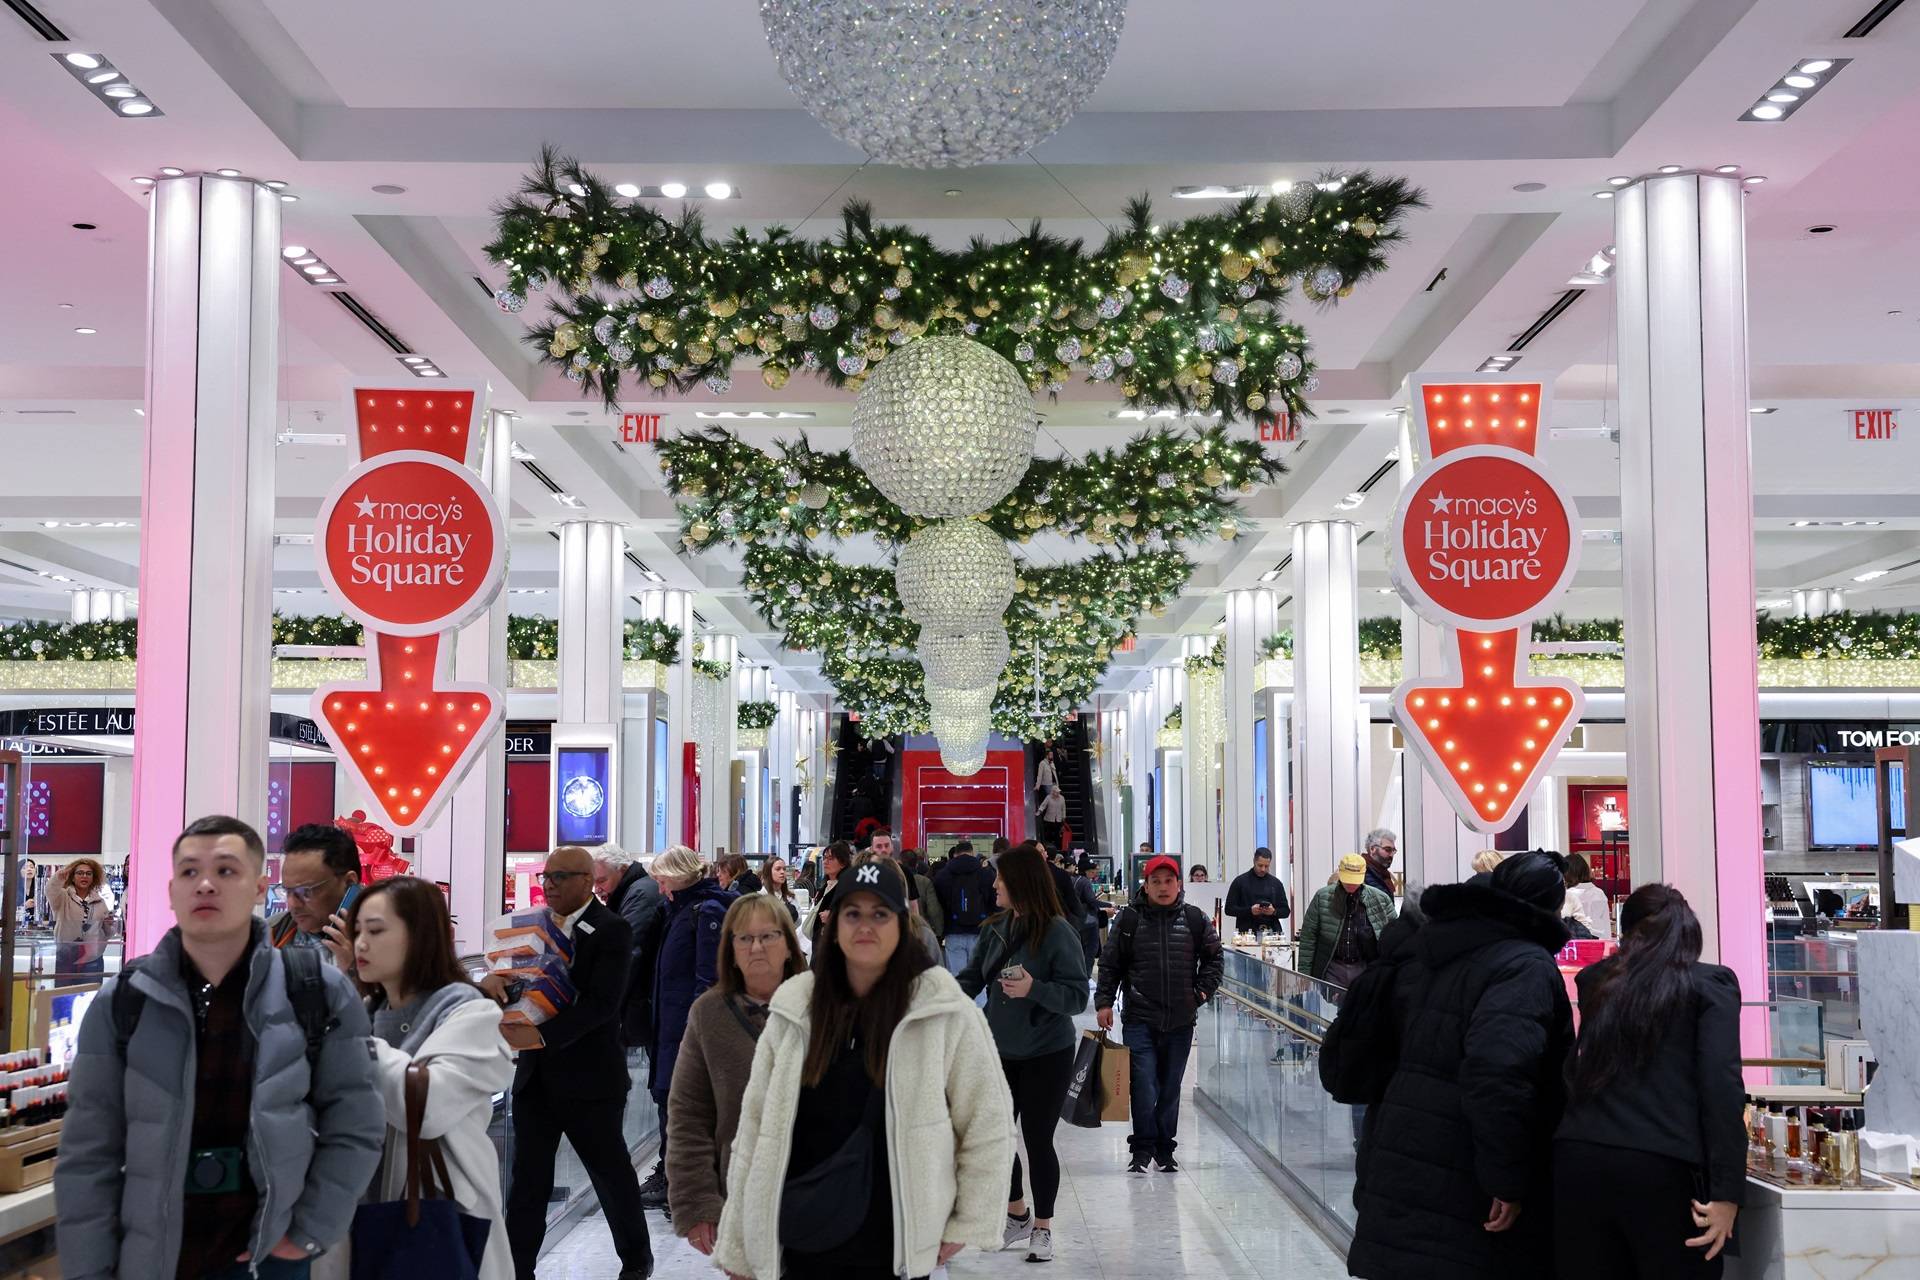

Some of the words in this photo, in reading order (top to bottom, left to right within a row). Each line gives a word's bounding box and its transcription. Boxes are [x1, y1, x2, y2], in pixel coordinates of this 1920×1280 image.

[624, 415, 660, 442] EXIT
[1856, 411, 1892, 439] EXIT
[380, 495, 463, 526] macy's
[1455, 489, 1537, 520] macy's
[347, 523, 472, 562] Holiday
[1424, 519, 1547, 557] Holiday
[351, 554, 465, 592] Square
[1429, 551, 1541, 588] Square
[95, 714, 136, 731] LAU
[1837, 730, 1883, 747] TOM
[856, 865, 880, 884] NY
